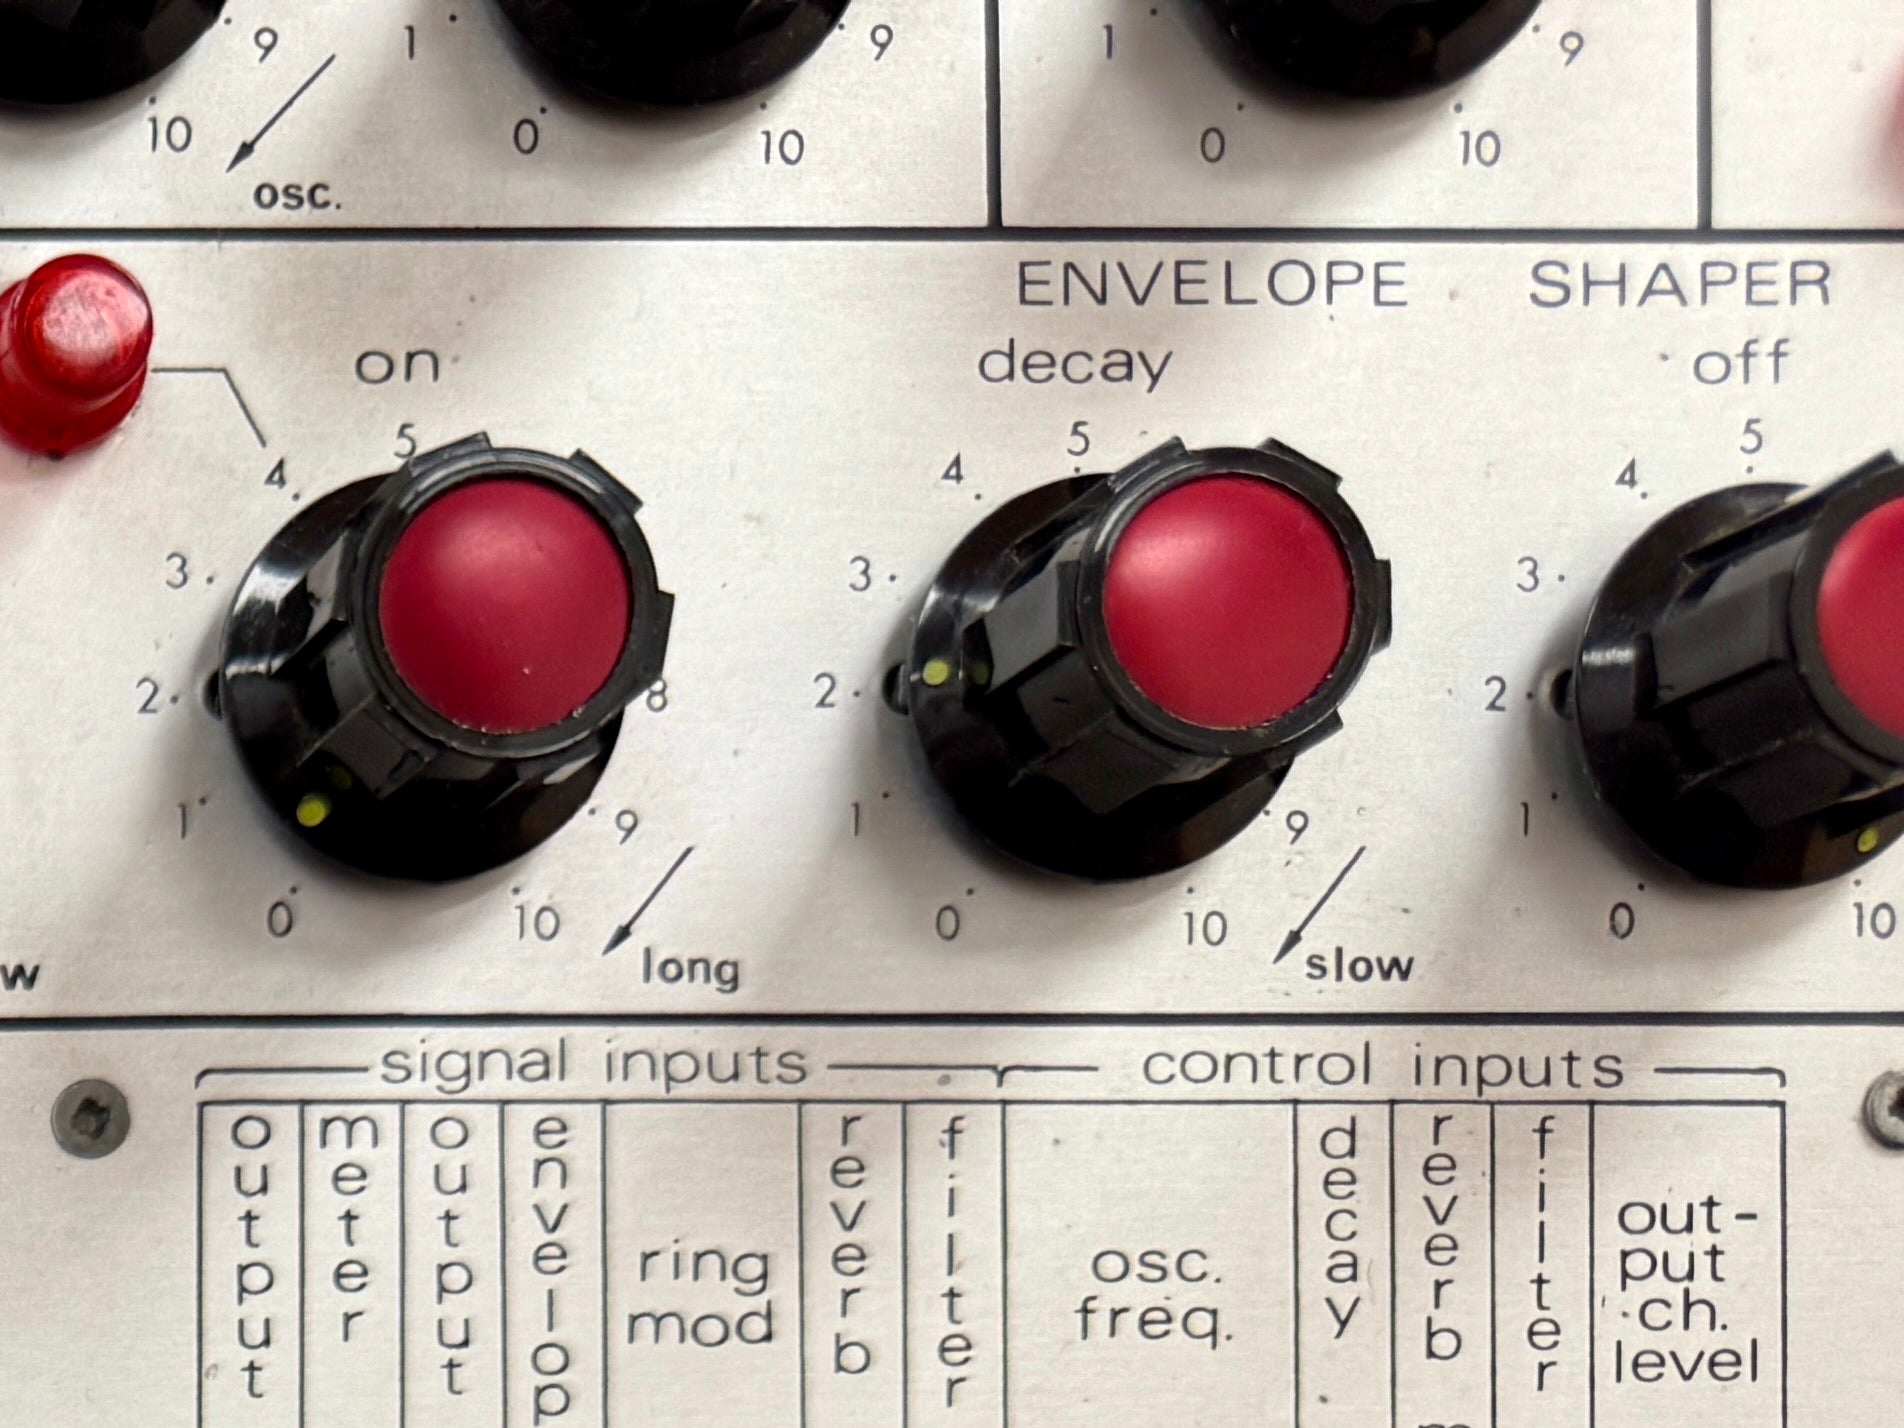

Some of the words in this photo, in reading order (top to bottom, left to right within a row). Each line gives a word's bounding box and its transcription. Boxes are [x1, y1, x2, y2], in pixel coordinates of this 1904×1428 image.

[254, 182, 342, 211] osc.
[1019, 259, 1408, 306] ENVELOPE
[1530, 259, 1831, 308] SHAPER
[355, 349, 439, 384] on
[978, 337, 1173, 393] decay
[1694, 338, 1789, 385] off
[643, 946, 740, 994] long
[1306, 946, 1414, 982] slow
[381, 1037, 567, 1095] signal
[606, 1046, 809, 1094] inputs
[1143, 1041, 1370, 1085] control
[1415, 1050, 1623, 1098] inputs
[1618, 1195, 1758, 1235] out-
[640, 1249, 771, 1297] ring
[1092, 1249, 1223, 1283] osc.
[1620, 1243, 1725, 1292] put
[628, 1299, 776, 1347] mod
[1074, 1295, 1233, 1351] freq.
[1639, 1286, 1729, 1332] ch.
[1616, 1338, 1758, 1383] level
